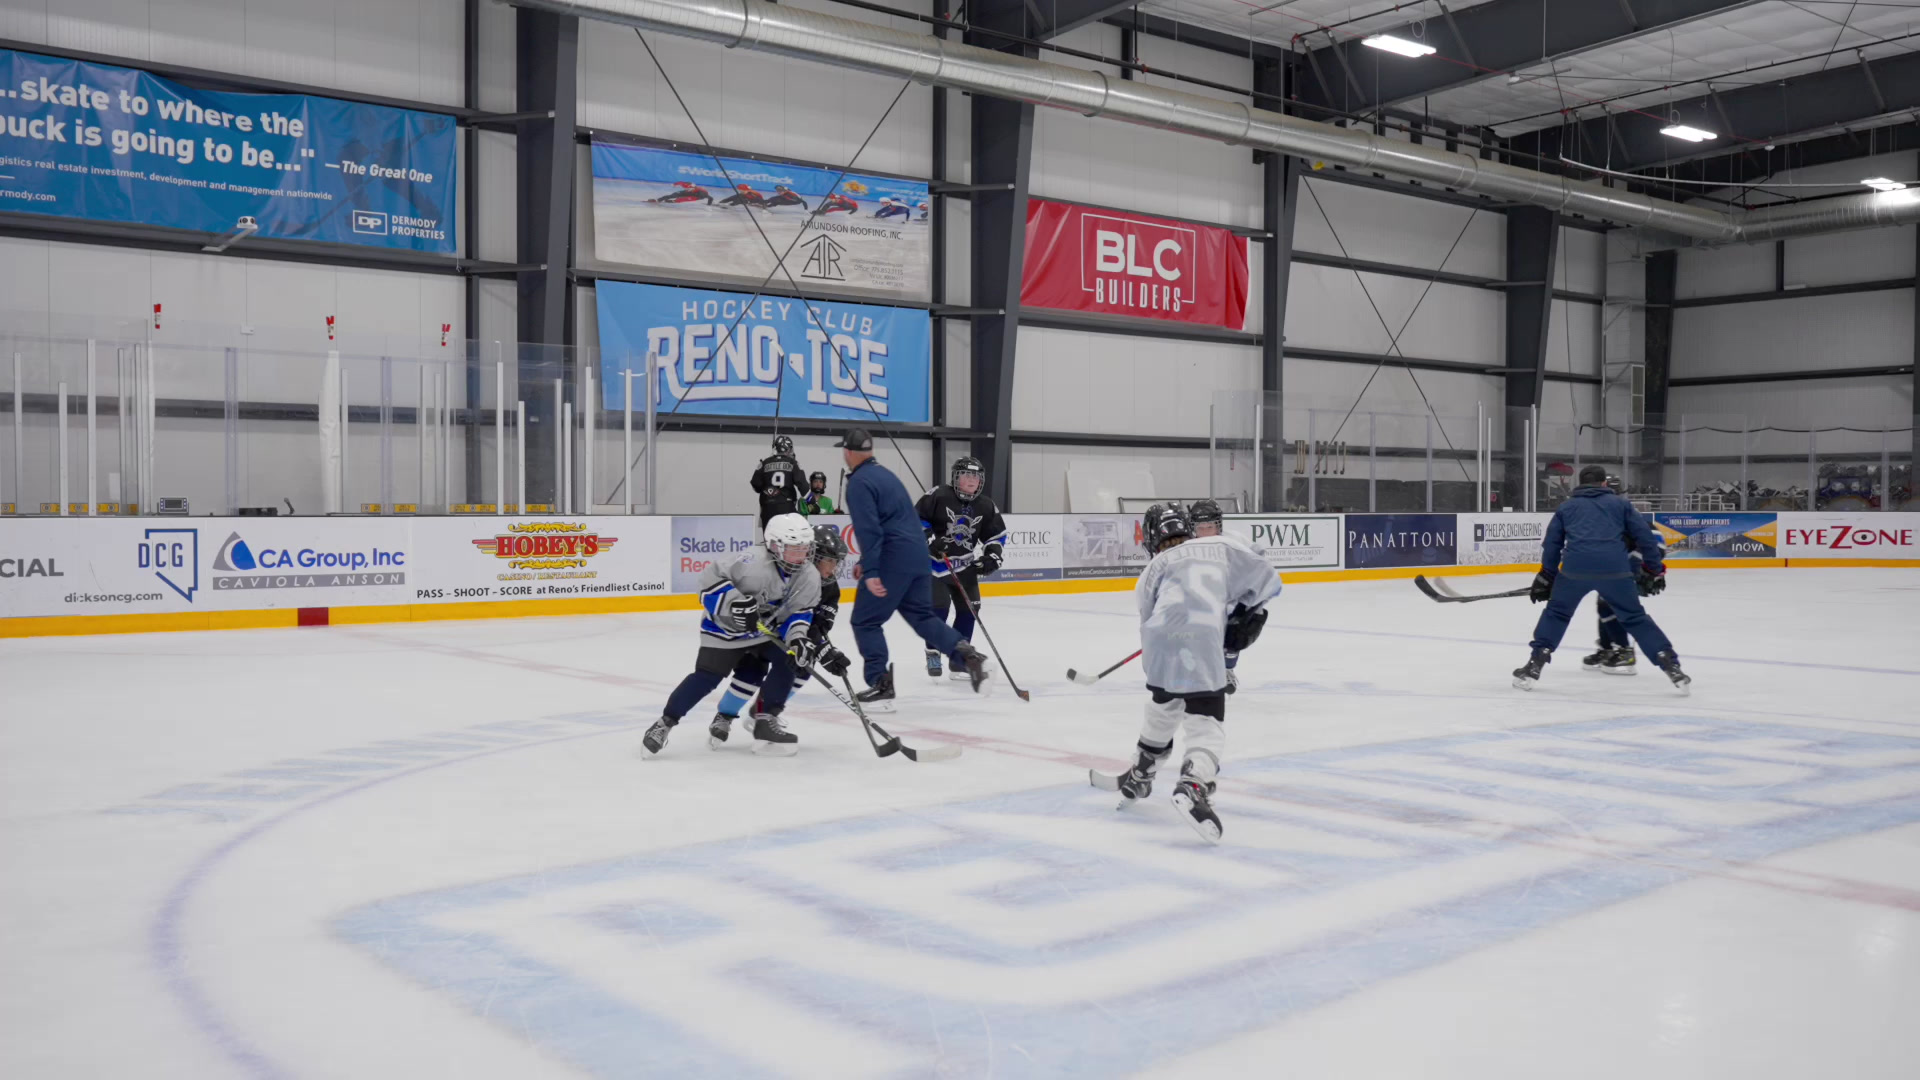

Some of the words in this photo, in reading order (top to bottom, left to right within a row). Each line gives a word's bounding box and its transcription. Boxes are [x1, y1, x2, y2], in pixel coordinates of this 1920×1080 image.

[119, 90, 148, 116] to
[157, 99, 252, 131] where
[260, 112, 304, 137] the
[75, 120, 102, 146] is
[112, 129, 194, 164] going
[204, 138, 233, 163] to
[35, 161, 56, 169] real
[58, 164, 88, 174] estate
[91, 166, 147, 180] investment,
[150, 172, 207, 188] development
[209, 181, 226, 191] and
[229, 183, 284, 198] management
[286, 189, 332, 200] nationwide
[370, 163, 407, 180] Great
[409, 169, 433, 183] One
[392, 215, 437, 228] DERMODY
[392, 226, 445, 240] PROPERTIES
[800, 220, 849, 233] AMUNDSON
[850, 226, 889, 239] ROOFING,
[1096, 229, 1182, 282] BLC
[1096, 278, 1182, 312] BUILDERS
[682, 300, 792, 321] HOCKEY
[807, 307, 873, 335] CLUB
[647, 323, 780, 404] RENO
[806, 328, 888, 412] ICE
[771, 471, 785, 488] 9
[495, 534, 599, 558] HOBEY'S
[680, 537, 726, 553] Skate
[1251, 524, 1310, 547] PWM
[1349, 531, 1455, 548] PANATTONI
[138, 543, 183, 568] DCG
[258, 549, 294, 568] CA
[297, 548, 368, 571] Group,
[372, 548, 405, 566] Inc
[0, 558, 64, 578] CIAL
[218, 576, 316, 589] CAVIOLA
[331, 574, 400, 586] ANSON
[417, 589, 444, 599] PASS
[453, 587, 490, 597] SHOOT
[500, 586, 532, 596] SCORE
[536, 586, 546, 595] at
[548, 585, 579, 595] Reno's
[581, 582, 630, 593] Friendliest
[632, 581, 665, 592] Casino!
